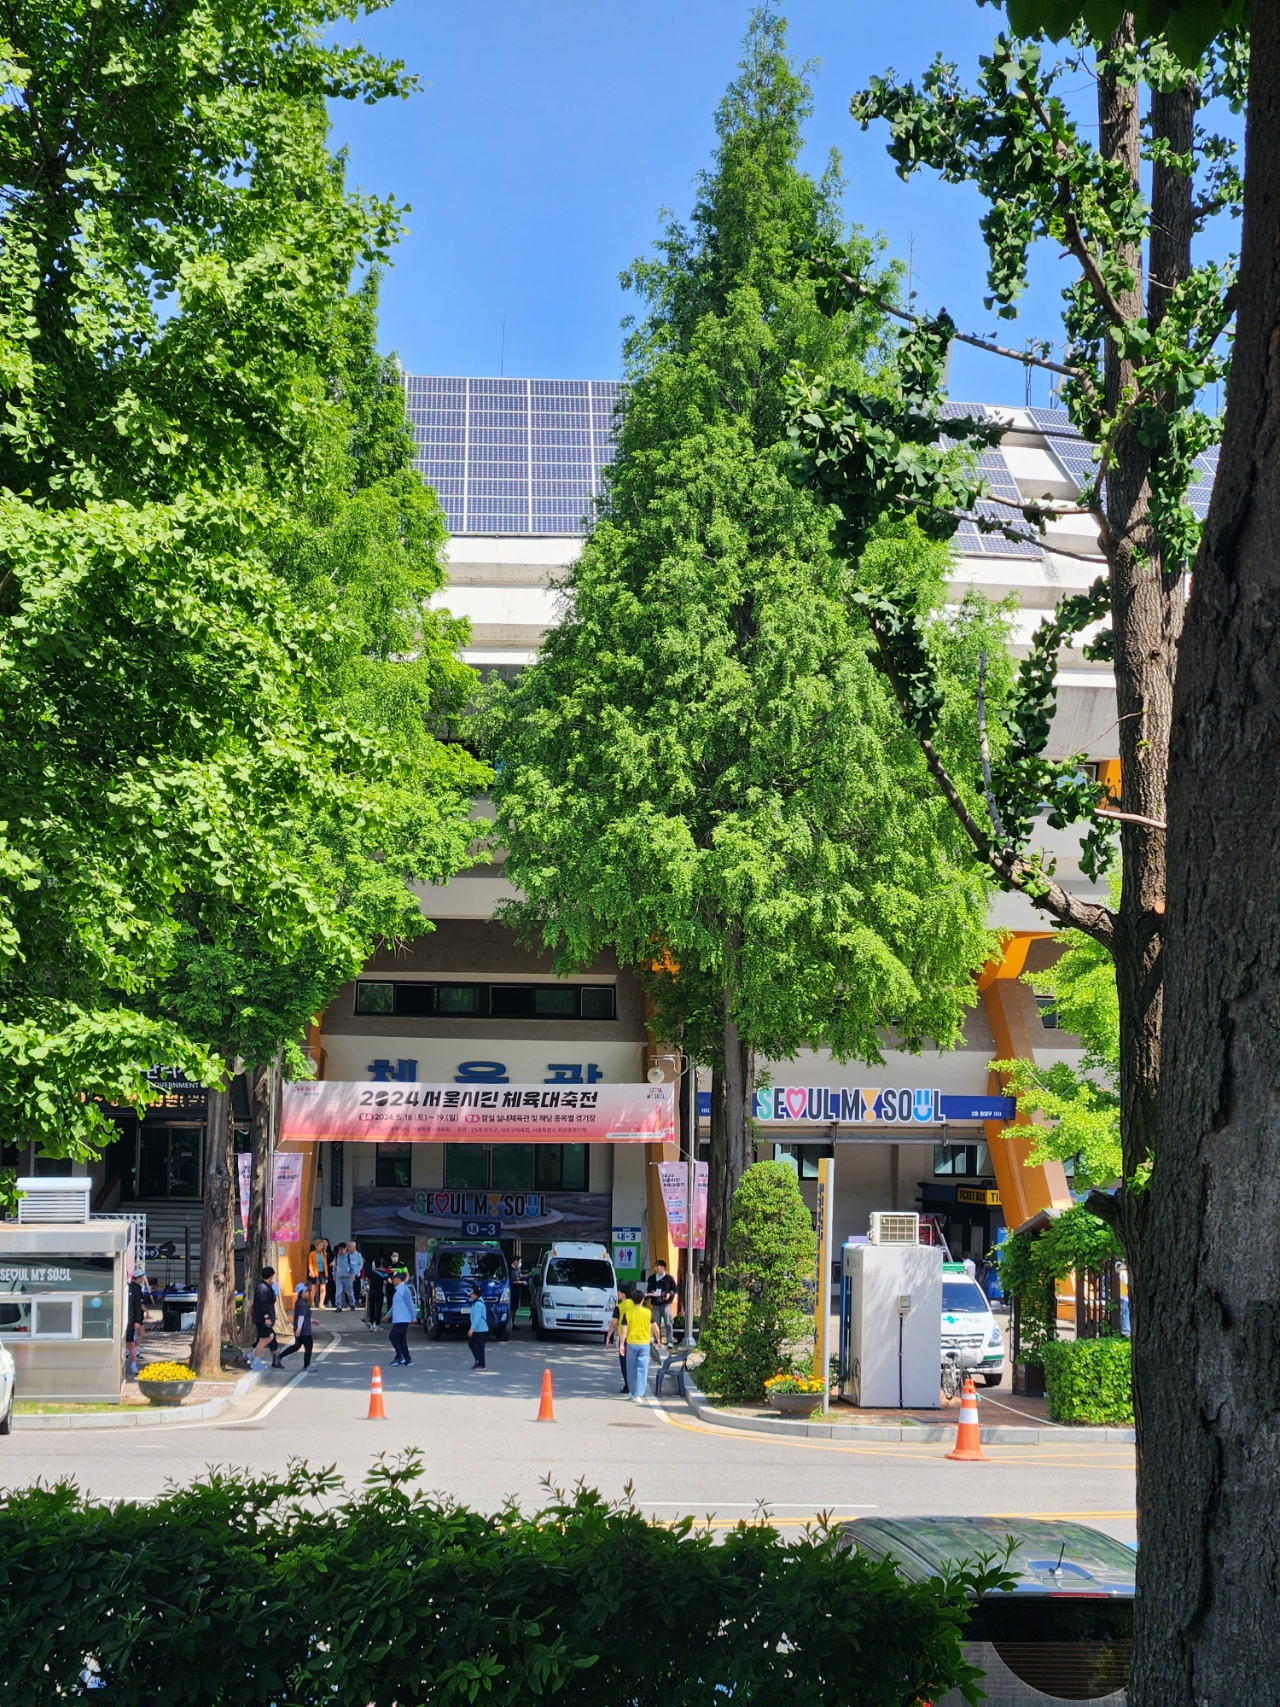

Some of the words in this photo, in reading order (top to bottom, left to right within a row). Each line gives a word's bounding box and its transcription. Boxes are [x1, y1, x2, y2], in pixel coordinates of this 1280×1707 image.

[359, 1090, 420, 1107] 2024
[422, 1090, 499, 1108] 서울시민
[502, 1091, 598, 1109] 체육대축전
[883, 1088, 945, 1122] SOUL
[481, 1114, 495, 1122] 잠실
[576, 1115, 596, 1123] 경기장
[958, 1190, 975, 1201] TICKET
[976, 1191, 986, 1202] BOX
[414, 1191, 469, 1215] SEOUL
[504, 1194, 549, 1217] SOUL
[617, 1232, 636, 1241] 내-3
[47, 1268, 72, 1281] SOUL
